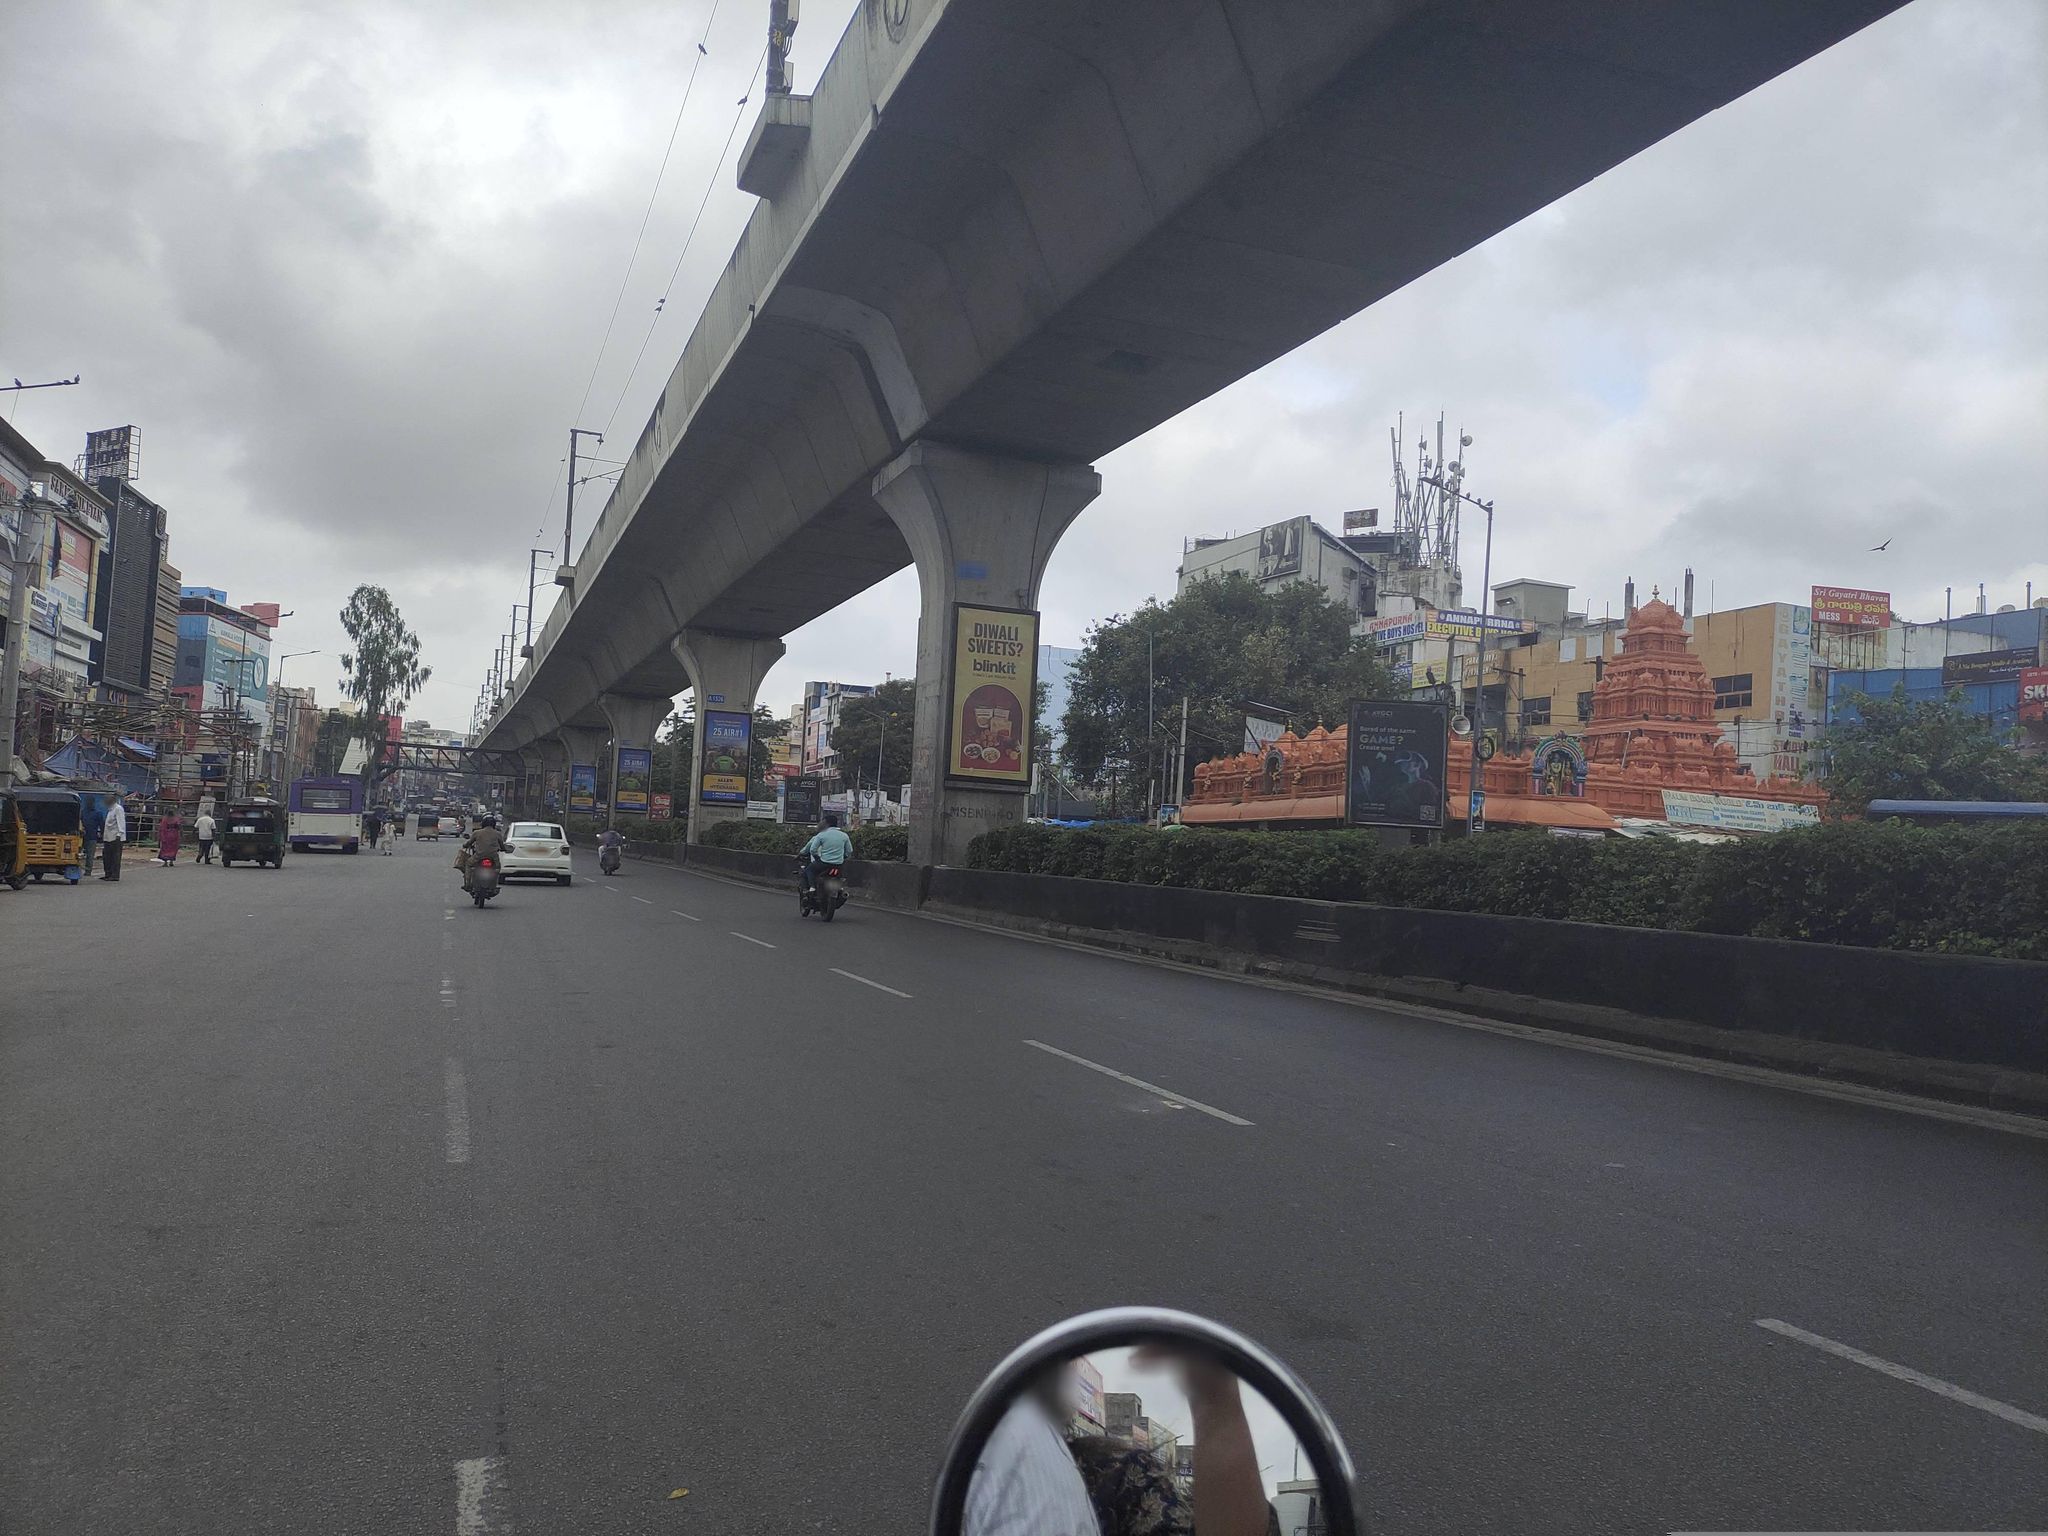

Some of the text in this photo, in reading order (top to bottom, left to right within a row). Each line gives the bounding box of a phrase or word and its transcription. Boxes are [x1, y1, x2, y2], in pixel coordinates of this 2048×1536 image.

[1814, 588, 1889, 602] Sri Gayatri Bhavan
[1818, 611, 1840, 621] MESS
[974, 622, 1019, 641] DIWALI
[1387, 626, 1402, 639] BOYS
[1403, 621, 1425, 636] HOSTEL
[1427, 621, 1474, 637] EXECUTIVE
[968, 638, 1024, 657] SWEETS?
[973, 659, 1016, 674] blinkit
[2023, 684, 2048, 700] SK
[713, 728, 722, 736] 25
[1360, 734, 1404, 745] GAME?
